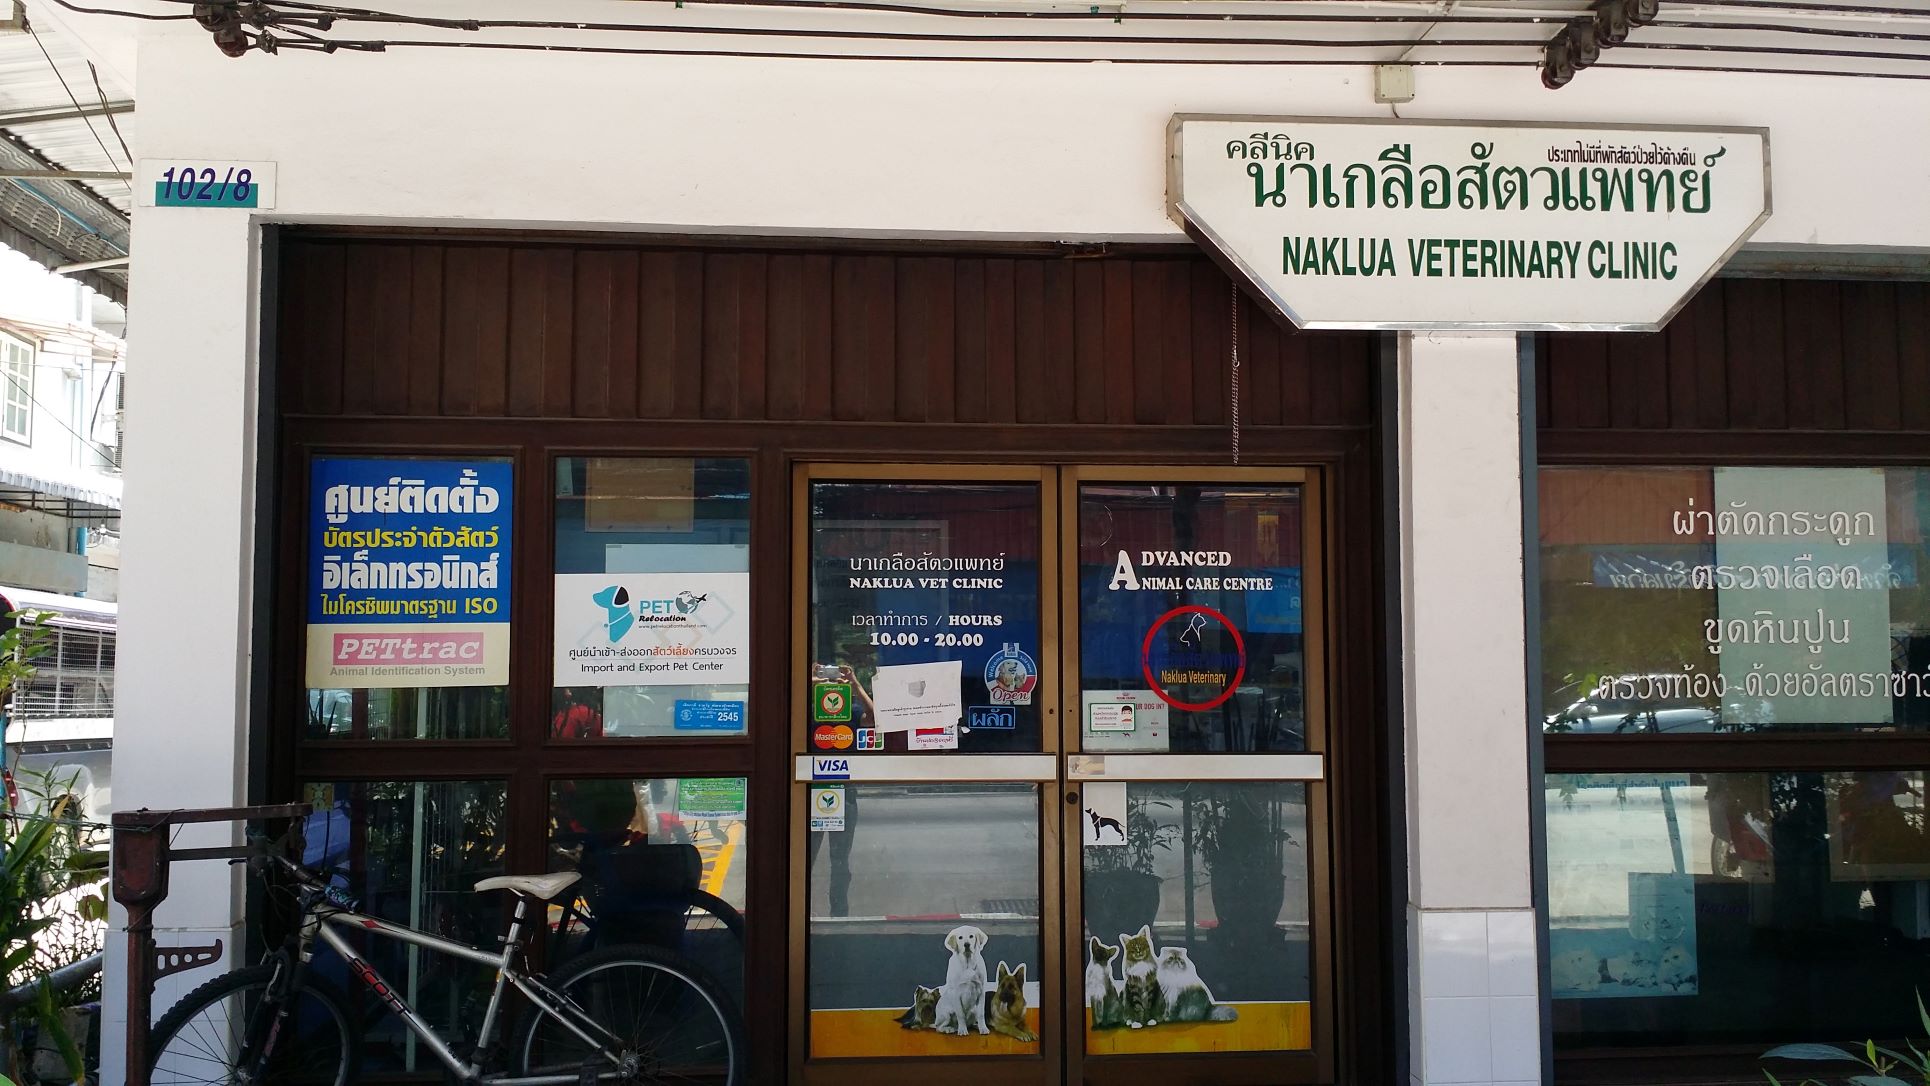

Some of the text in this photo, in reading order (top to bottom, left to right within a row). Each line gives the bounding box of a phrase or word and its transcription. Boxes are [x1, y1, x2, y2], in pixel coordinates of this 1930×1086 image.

[1226, 132, 1315, 161] คลีนิค
[163, 167, 252, 202] 102/8
[1246, 142, 1727, 214] นาเกลือสัตวแพทย์
[1282, 236, 1678, 281] NAKLUA VETERINARY CLINIC
[325, 469, 500, 524] ศูนย์ติดตั้ง
[1673, 498, 1875, 546] ผ่าตัดกระดูก
[323, 526, 499, 548] บัตรประจำตัวสัตว์
[322, 550, 500, 590] อิเล็กทรอนิกส์
[850, 552, 1006, 572] นาเกลือสัตวแพทย์
[1691, 553, 1862, 590] ตรวจเลือด
[849, 578, 1003, 589] NAKLUA VET CLINIC
[1186, 578, 1220, 591] CARE
[1223, 578, 1273, 591] CENTRE
[321, 594, 498, 619] ไมโครชิพมาตรฐาน ISO
[639, 600, 674, 614] PET
[852, 610, 928, 627] เวลาทำการ
[949, 615, 1003, 626] HOURS
[869, 633, 919, 646] 10.00
[934, 633, 984, 647] 20.00
[1704, 609, 1851, 654] ขูดหินปูน
[338, 638, 480, 660] PETtrac
[569, 643, 737, 661] ศูนย์นำเข้า-ส่งออกสัตว์เลี้ยงครบวงจร
[329, 665, 486, 677] Animal Identification System
[581, 661, 724, 674] Import and Export Pet Center
[1161, 670, 1227, 686] Naklua Veterinary
[1599, 664, 1727, 699] ตรวจท้อง
[992, 687, 1030, 704] Open
[717, 711, 739, 722] 2545
[972, 708, 1013, 727] ผลัก
[815, 732, 853, 741] MasterCard
[817, 760, 849, 772] VISA
[352, 957, 411, 1015] SCOTT
